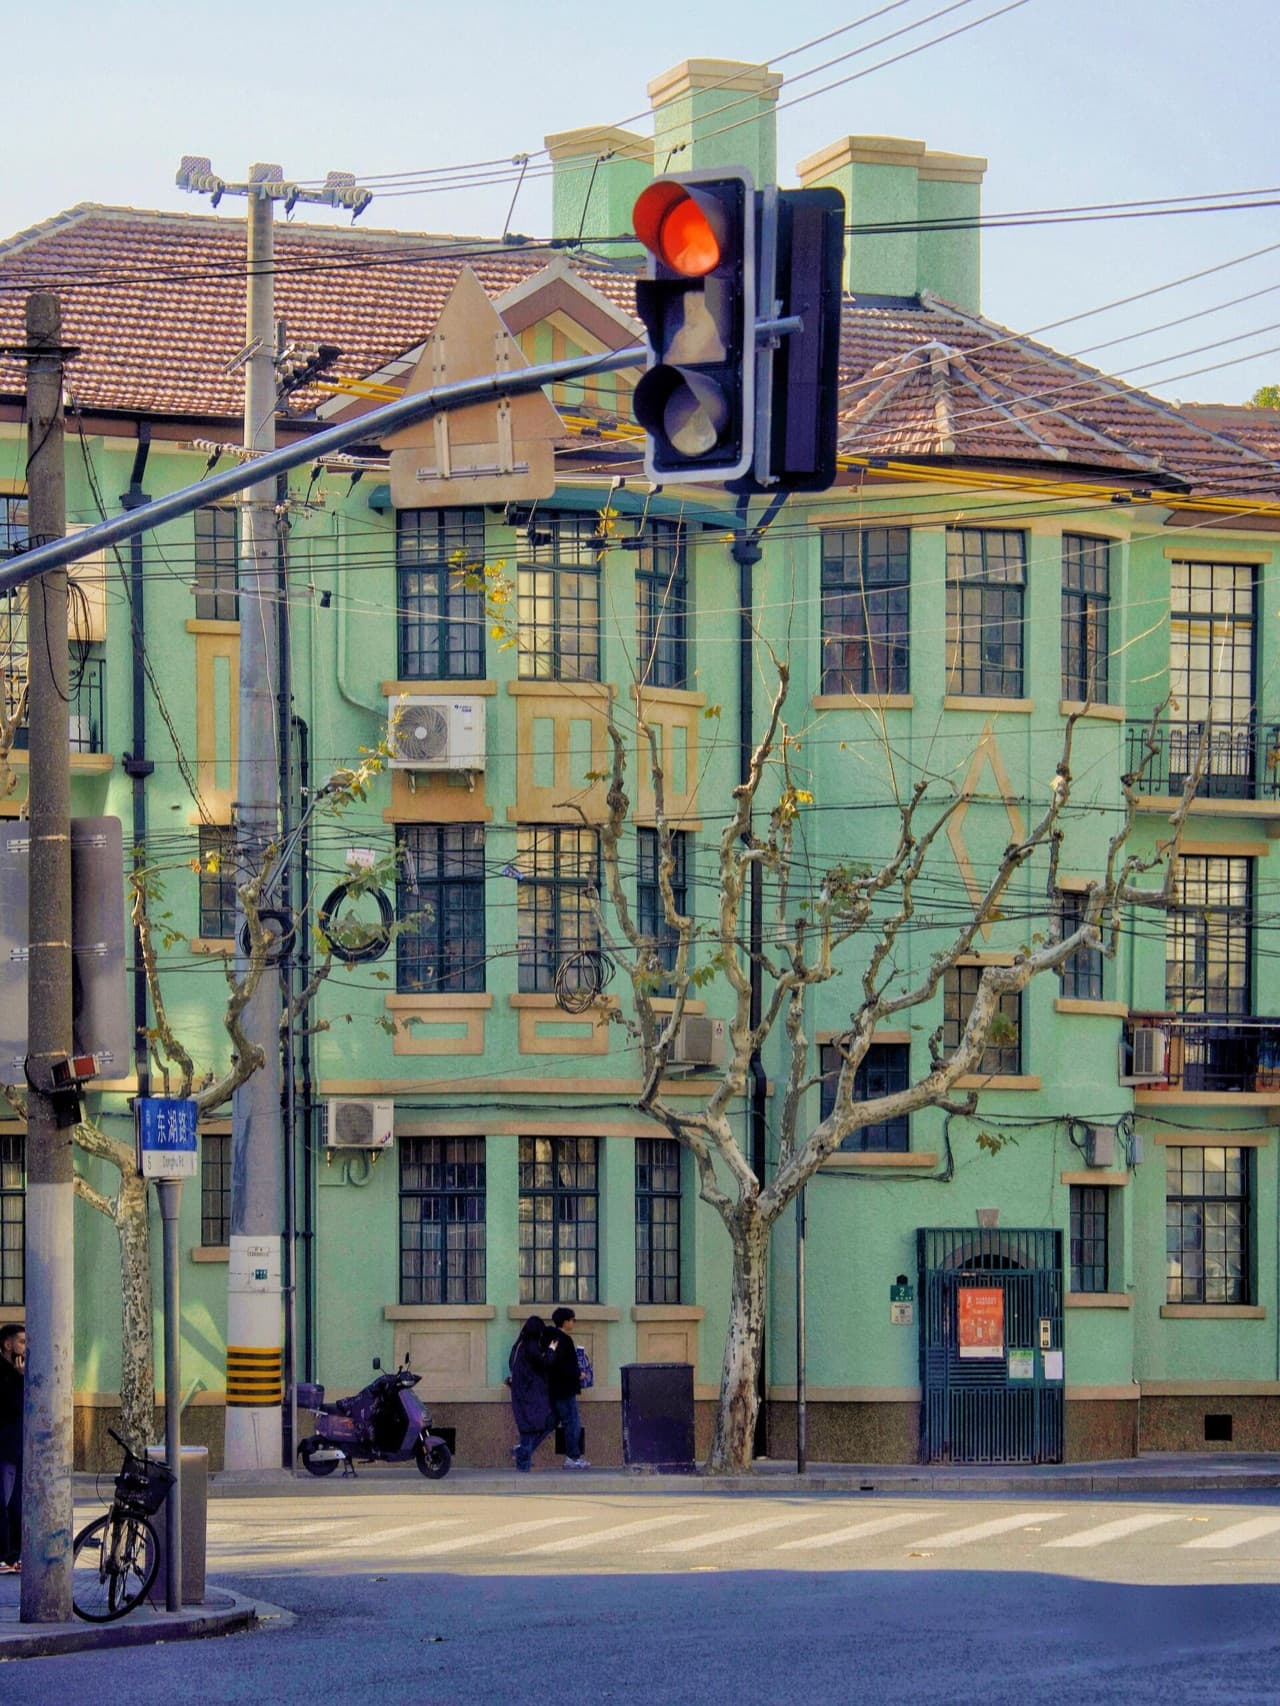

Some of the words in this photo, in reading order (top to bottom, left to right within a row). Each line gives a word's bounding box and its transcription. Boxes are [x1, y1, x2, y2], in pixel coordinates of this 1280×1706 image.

[156, 1108, 187, 1144] 东湖路
[899, 1287, 905, 1296] 2
